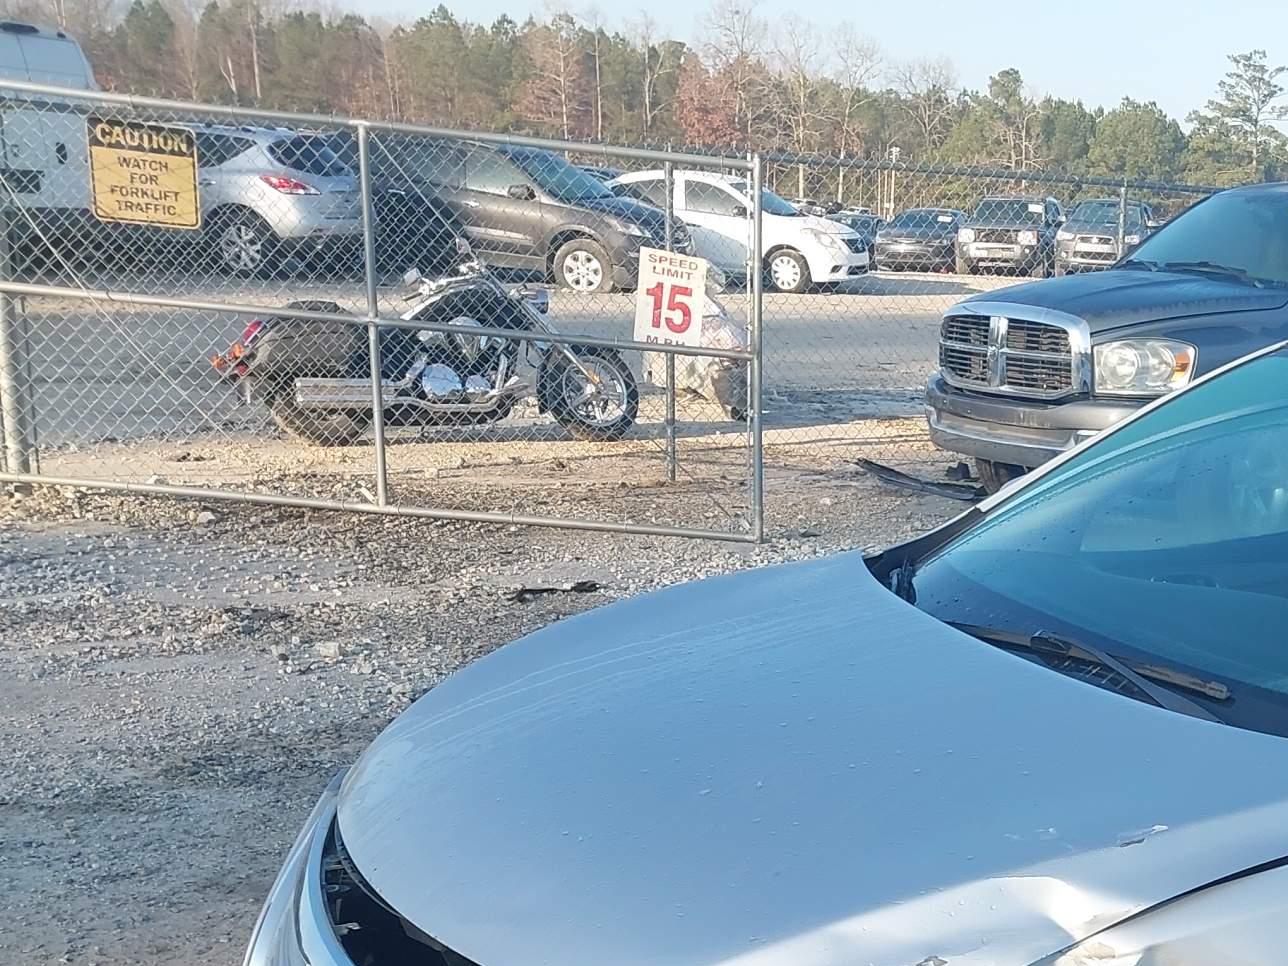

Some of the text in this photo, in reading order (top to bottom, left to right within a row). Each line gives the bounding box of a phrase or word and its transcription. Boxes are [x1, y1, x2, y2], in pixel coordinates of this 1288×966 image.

[95, 123, 188, 153] CAUTION
[117, 156, 168, 172] WATCH
[130, 173, 159, 186] FOR
[111, 185, 180, 203] FORKLIFT
[115, 200, 177, 216] TRAFFIC
[648, 253, 698, 271] SPEED
[652, 265, 694, 281] LIMIT
[646, 281, 693, 334] 15
